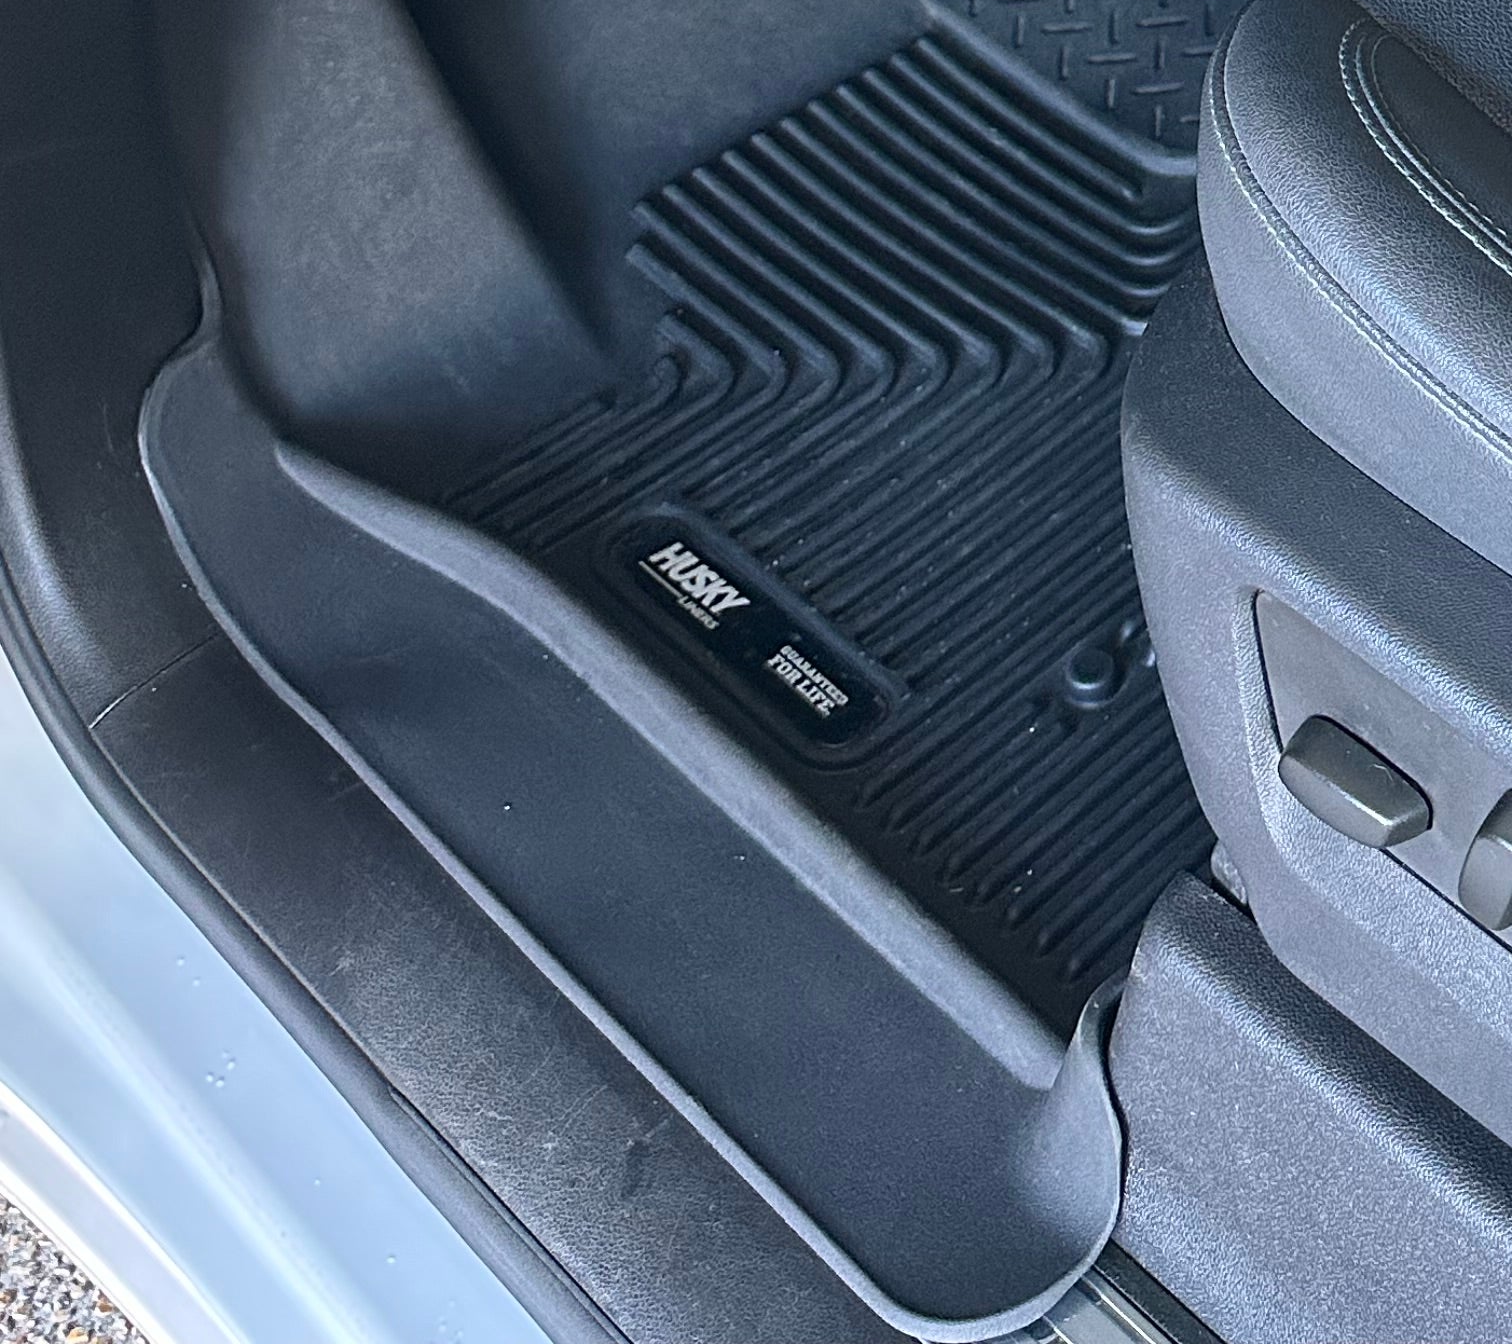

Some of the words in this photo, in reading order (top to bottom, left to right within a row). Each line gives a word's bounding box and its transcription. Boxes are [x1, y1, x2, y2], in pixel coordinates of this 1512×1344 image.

[649, 541, 751, 614] HUSKY
[768, 653, 802, 685] FOR
[796, 679, 836, 717] LIFE
[779, 644, 849, 706] GUARANTEED
